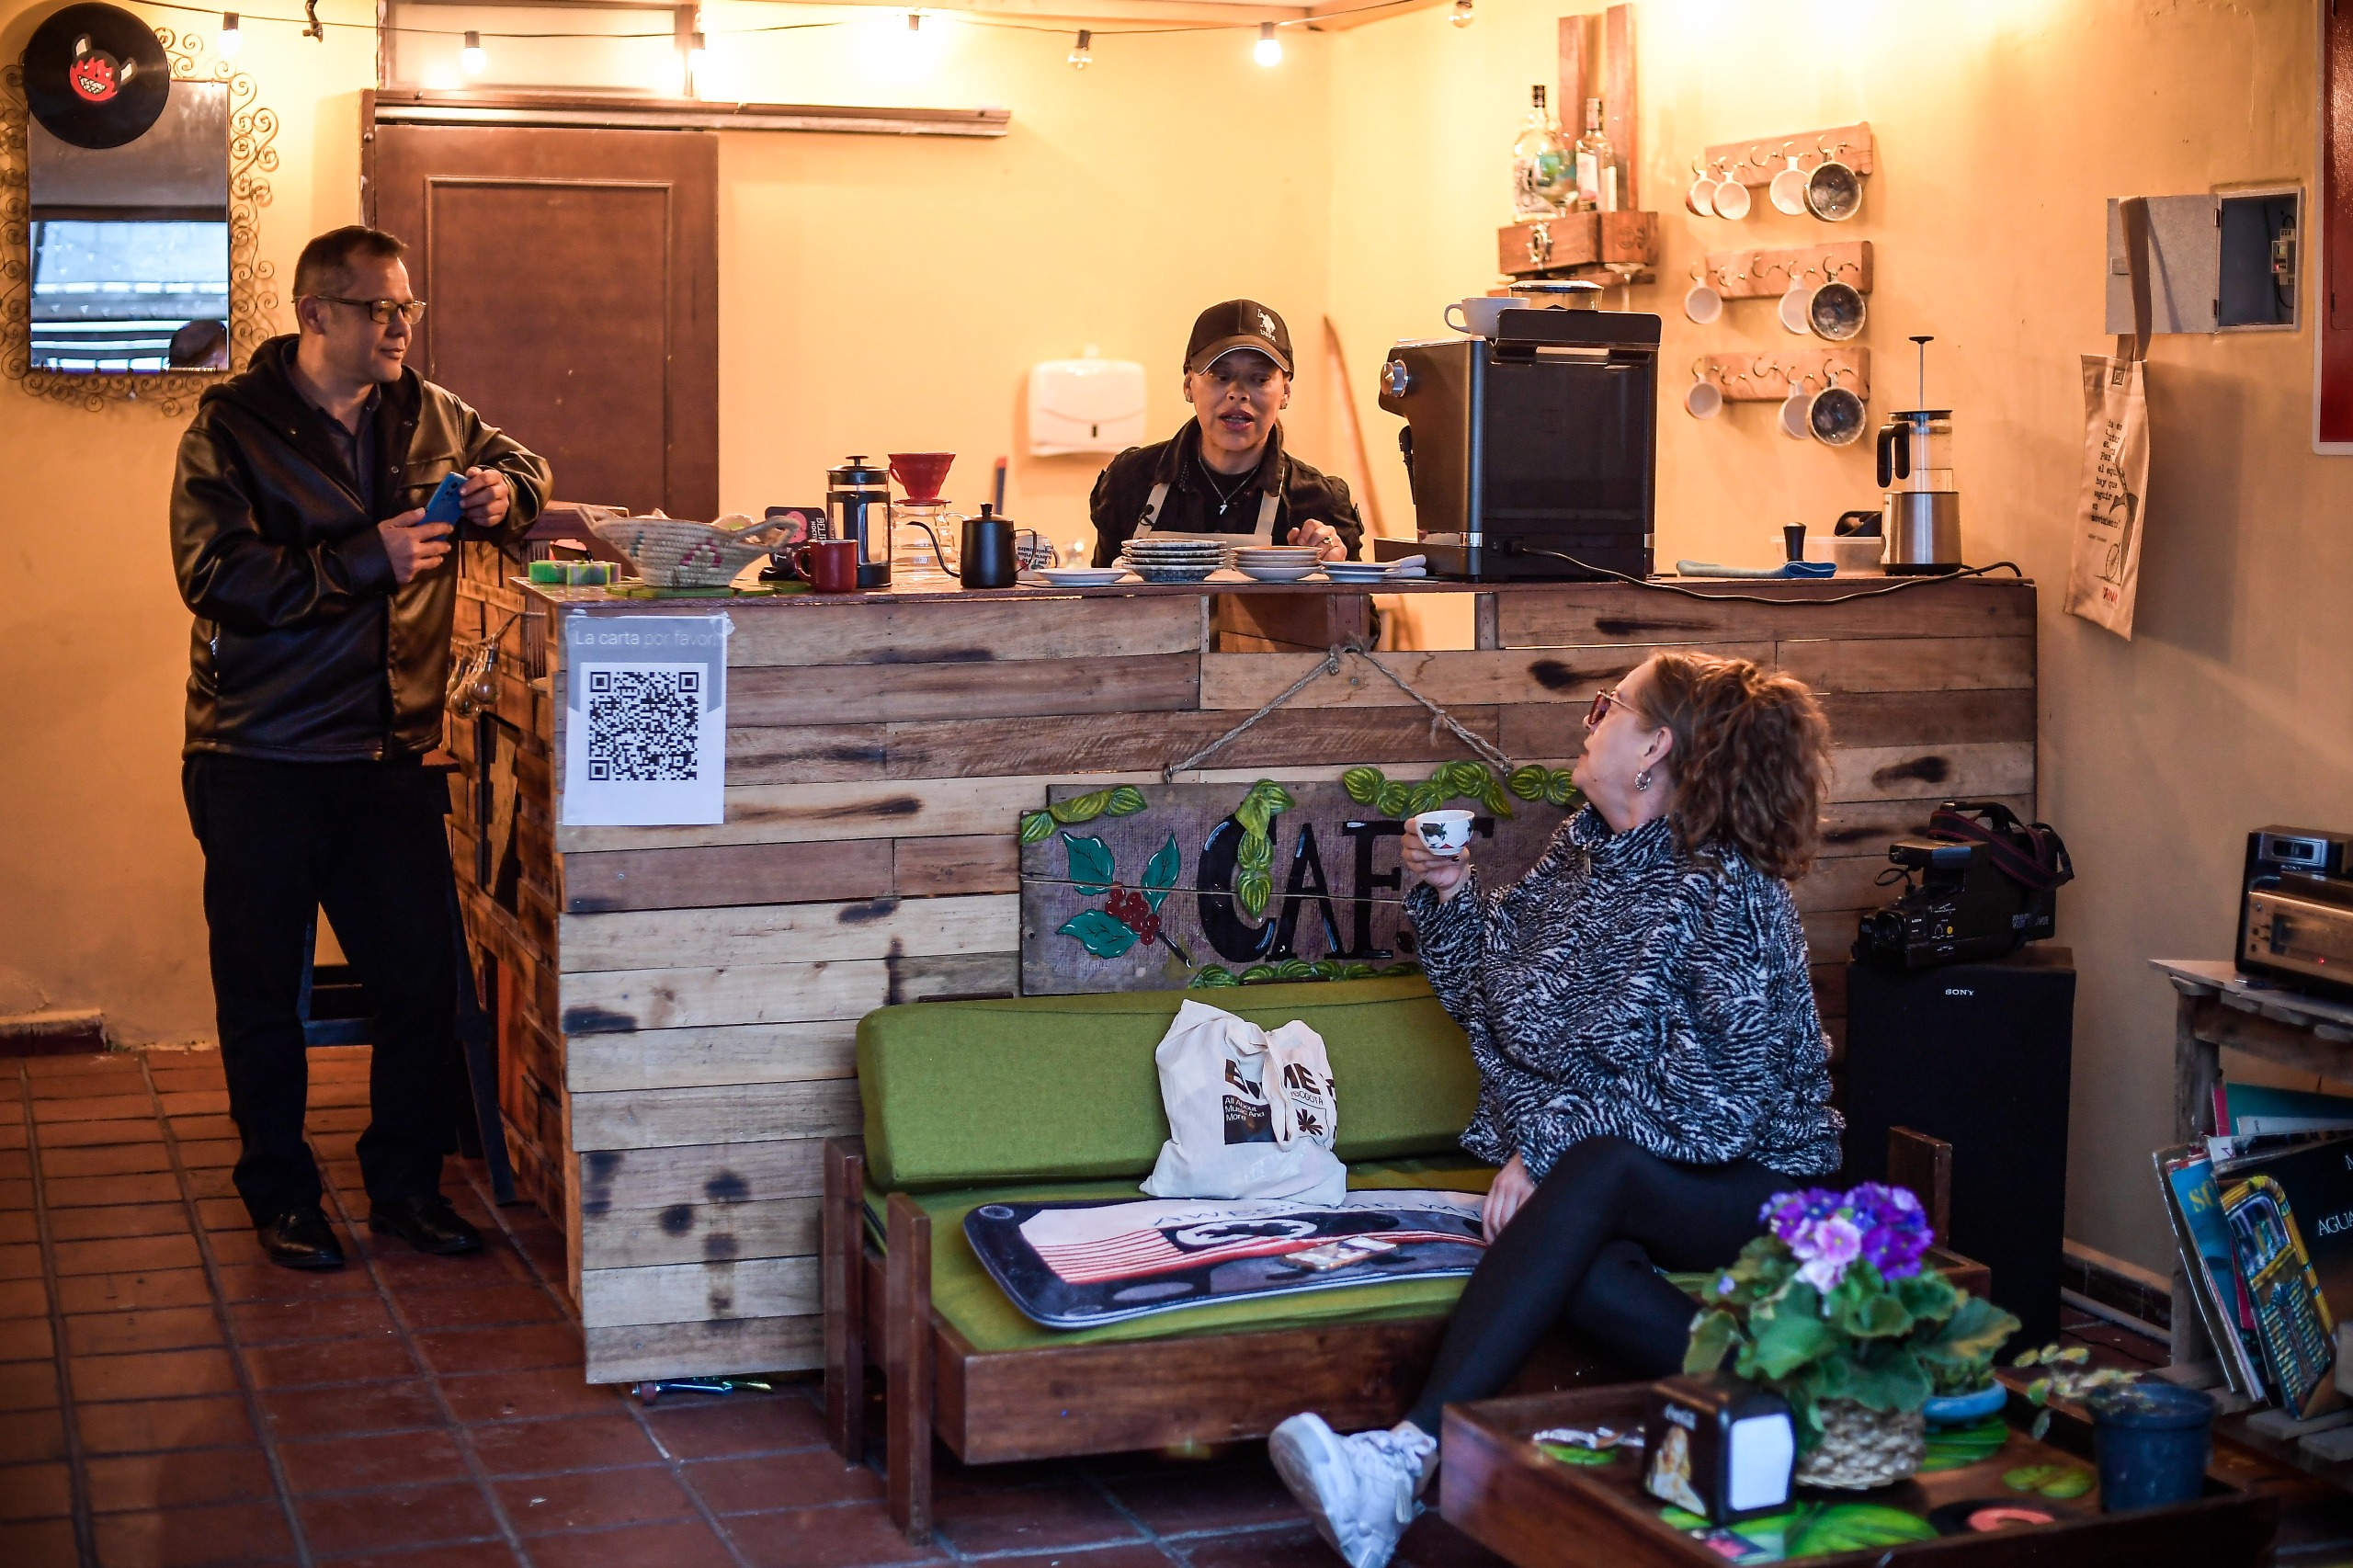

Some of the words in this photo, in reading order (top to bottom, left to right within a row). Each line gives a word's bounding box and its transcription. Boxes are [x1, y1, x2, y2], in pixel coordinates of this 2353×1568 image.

[575, 631, 595, 645] La
[598, 631, 640, 645] carta
[644, 633, 670, 647] por
[1197, 812, 1491, 963] CAF
[1945, 988, 1974, 996] SONY
[1224, 1096, 1234, 1105] All
[1235, 1099, 1257, 1112] About
[1224, 1105, 1247, 1116] Music
[1225, 1113, 1246, 1121] More
